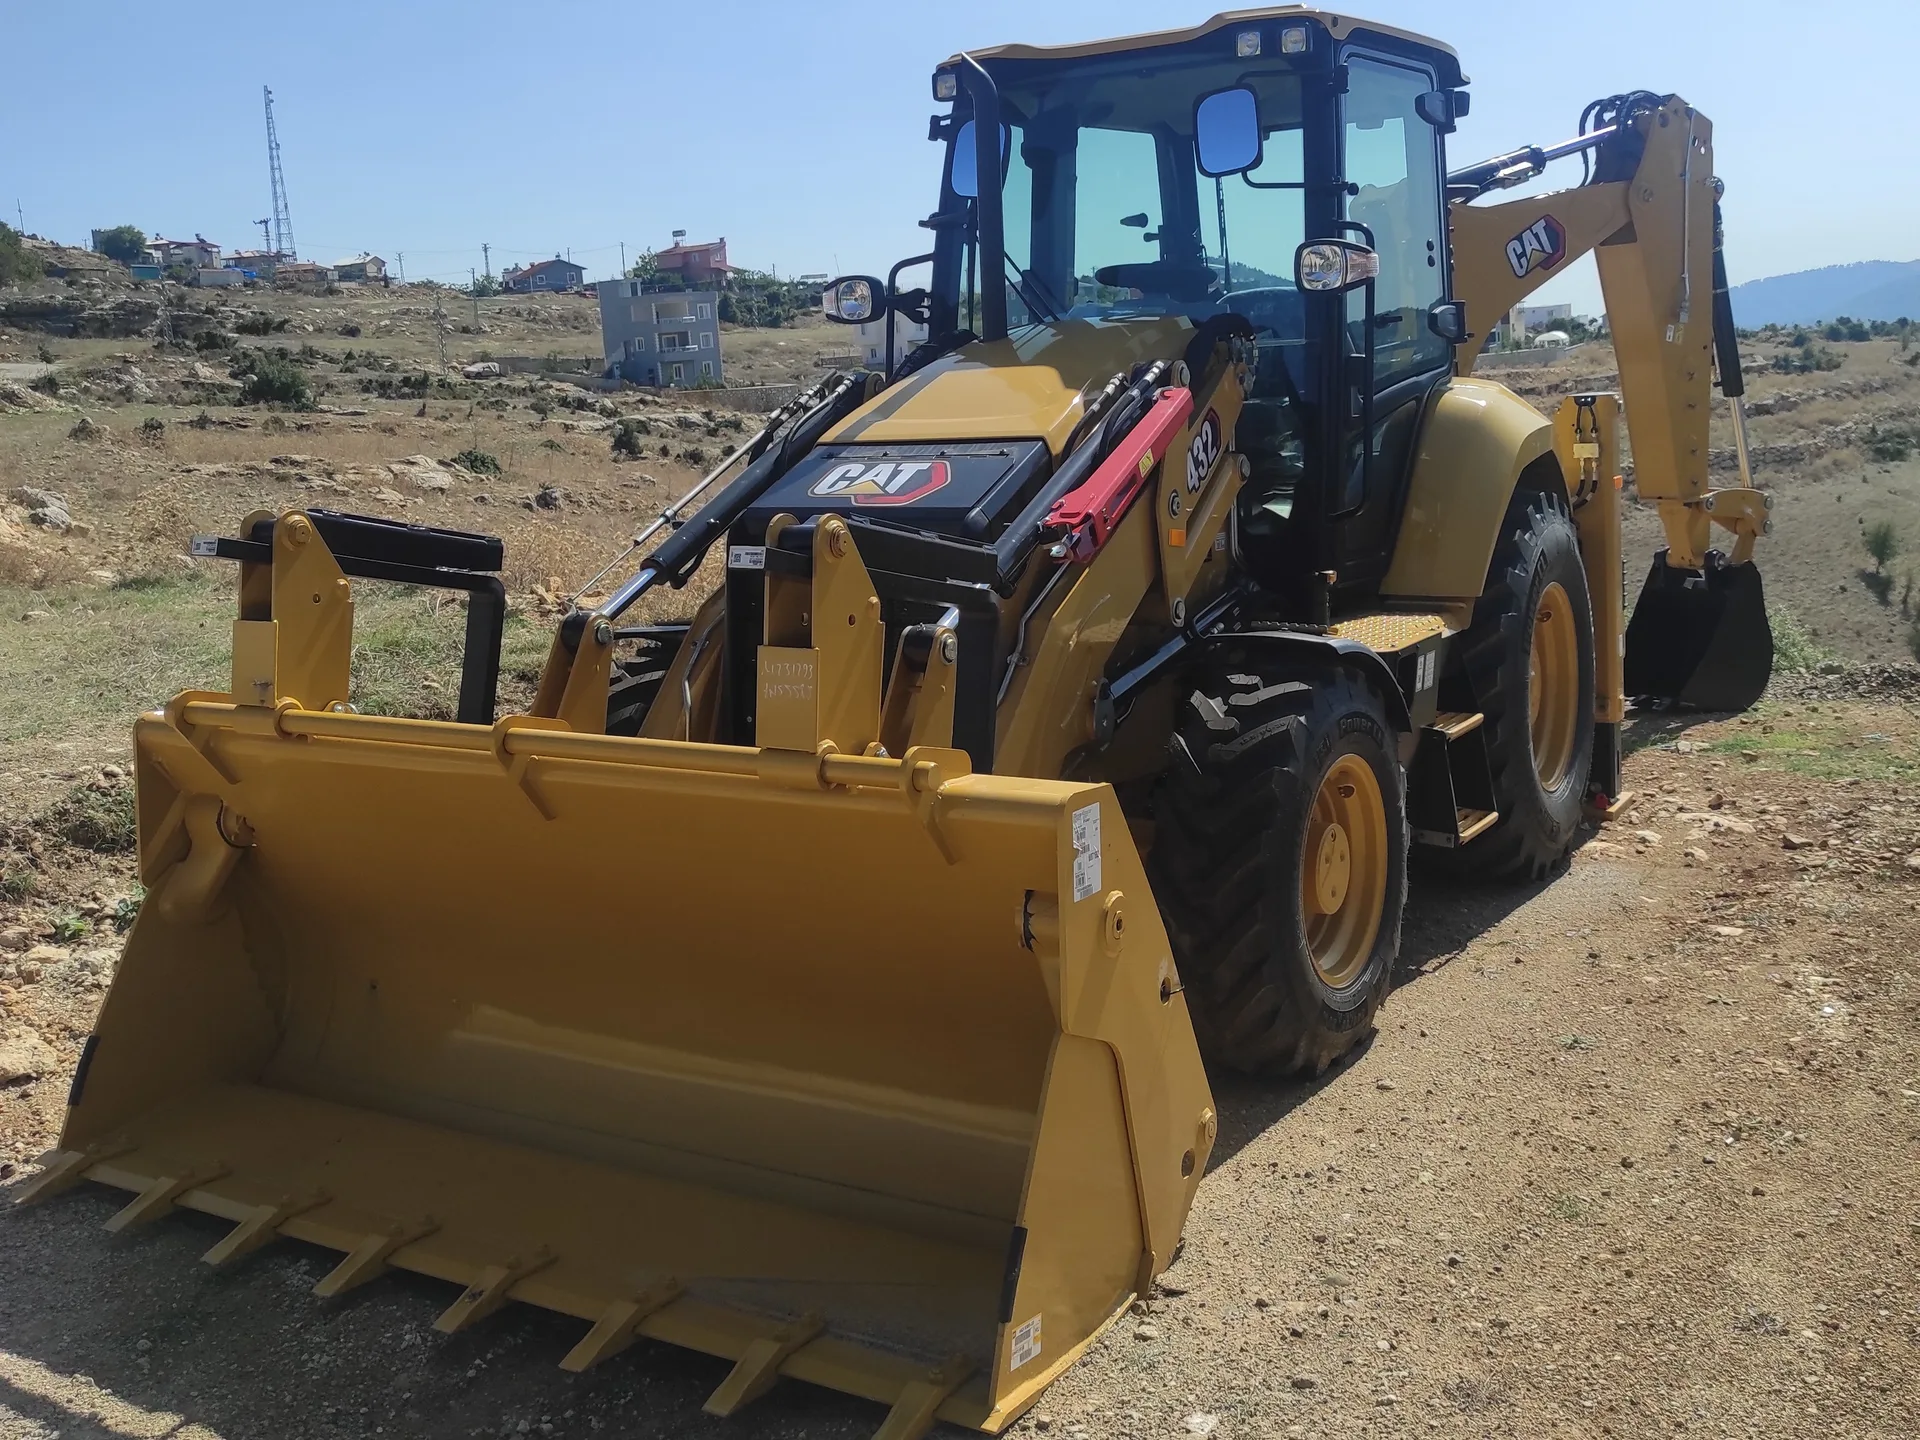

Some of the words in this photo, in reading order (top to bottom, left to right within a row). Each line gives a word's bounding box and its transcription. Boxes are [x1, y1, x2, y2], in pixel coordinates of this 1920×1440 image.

[1506, 218, 1553, 277] CAT
[813, 462, 932, 495] CAT
[1186, 420, 1218, 493] 432
